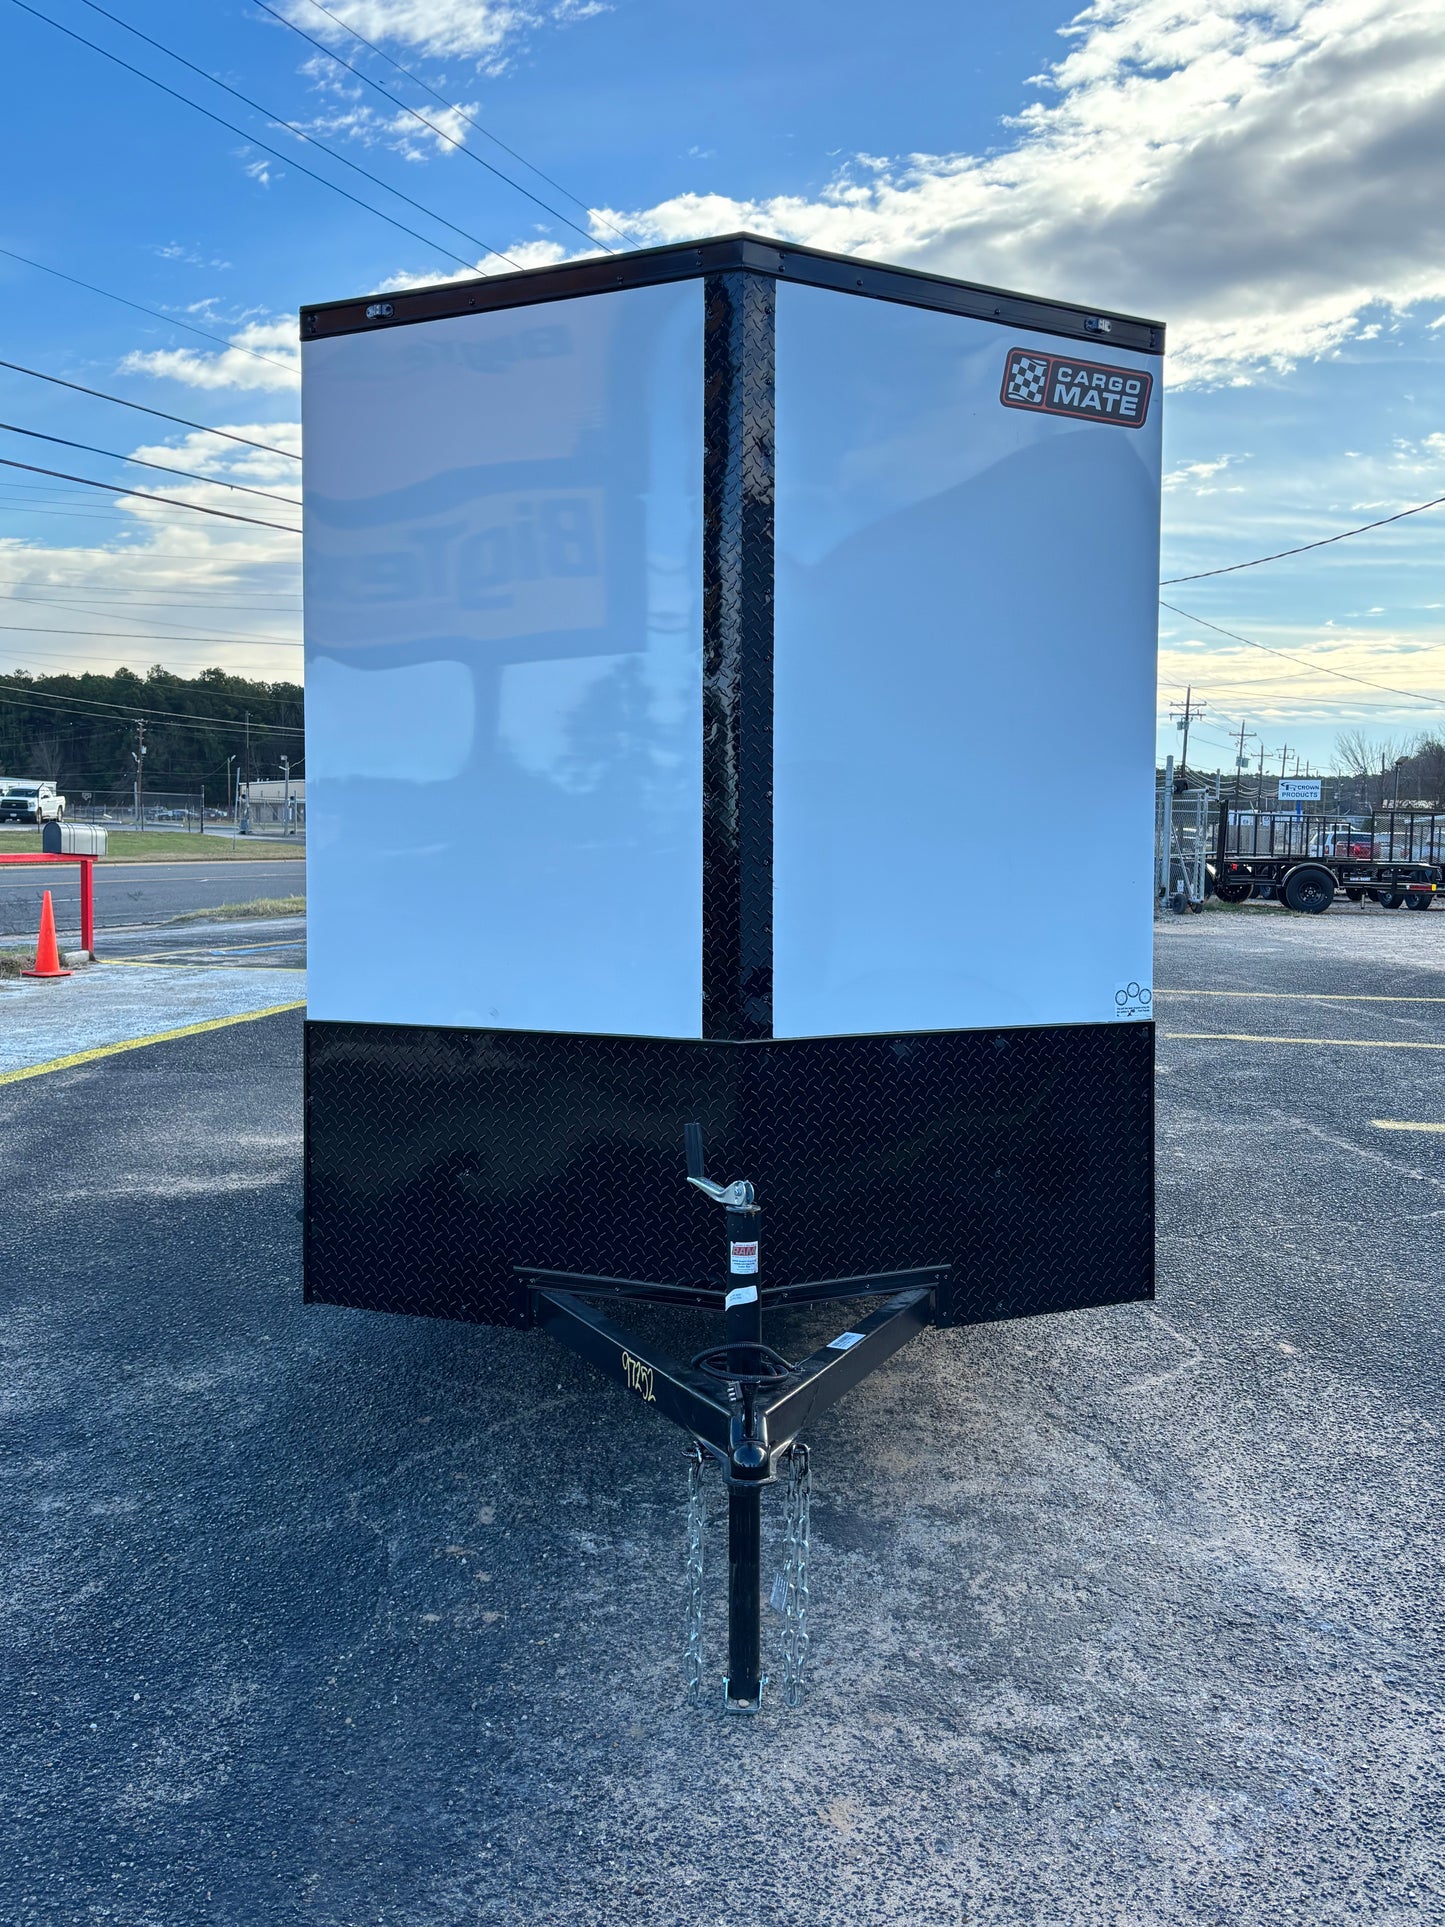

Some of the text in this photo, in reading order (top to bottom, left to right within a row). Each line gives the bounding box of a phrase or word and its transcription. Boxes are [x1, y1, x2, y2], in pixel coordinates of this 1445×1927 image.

[1057, 367, 1141, 395] CARGO
[1053, 383, 1139, 416] MATE
[732, 1246, 756, 1256] RAM
[621, 1351, 656, 1402] 97252
